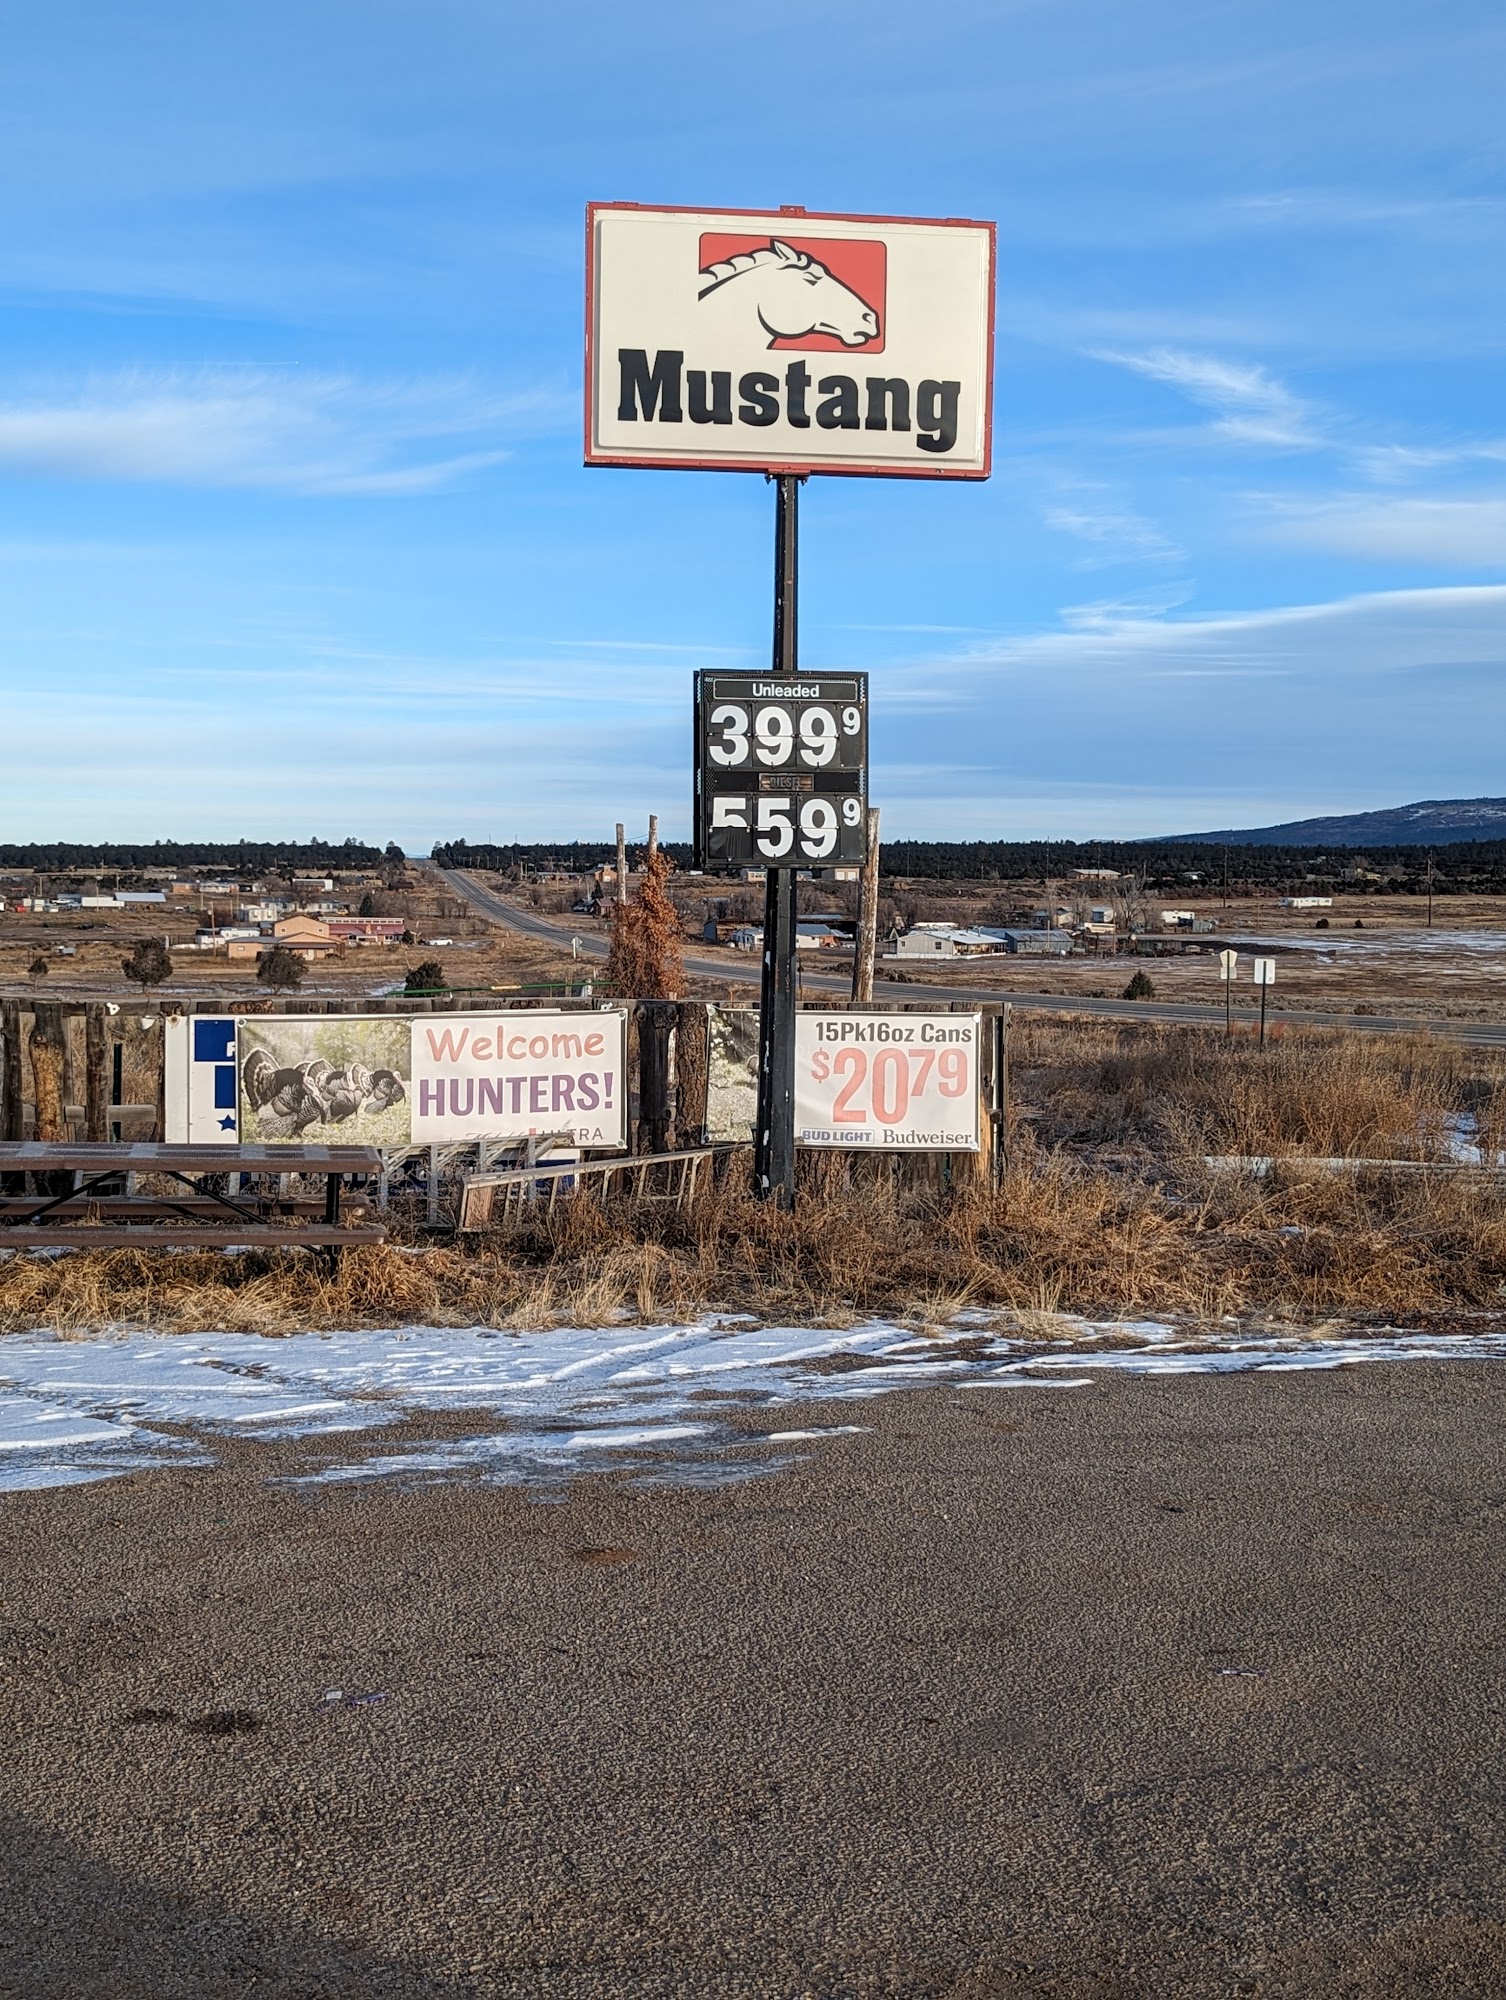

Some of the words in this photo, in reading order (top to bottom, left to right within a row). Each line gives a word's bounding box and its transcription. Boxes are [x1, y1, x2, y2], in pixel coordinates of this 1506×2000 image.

[617, 348, 961, 453] Mustang
[752, 683, 820, 698] Unleaded
[426, 1025, 605, 1063] Welcome
[921, 1022, 972, 1043] Cans
[419, 1072, 614, 1117] HUNTERS!
[802, 1130, 830, 1141] BUD
[832, 1131, 872, 1142] LIGHT
[882, 1128, 972, 1144] Budweiser
